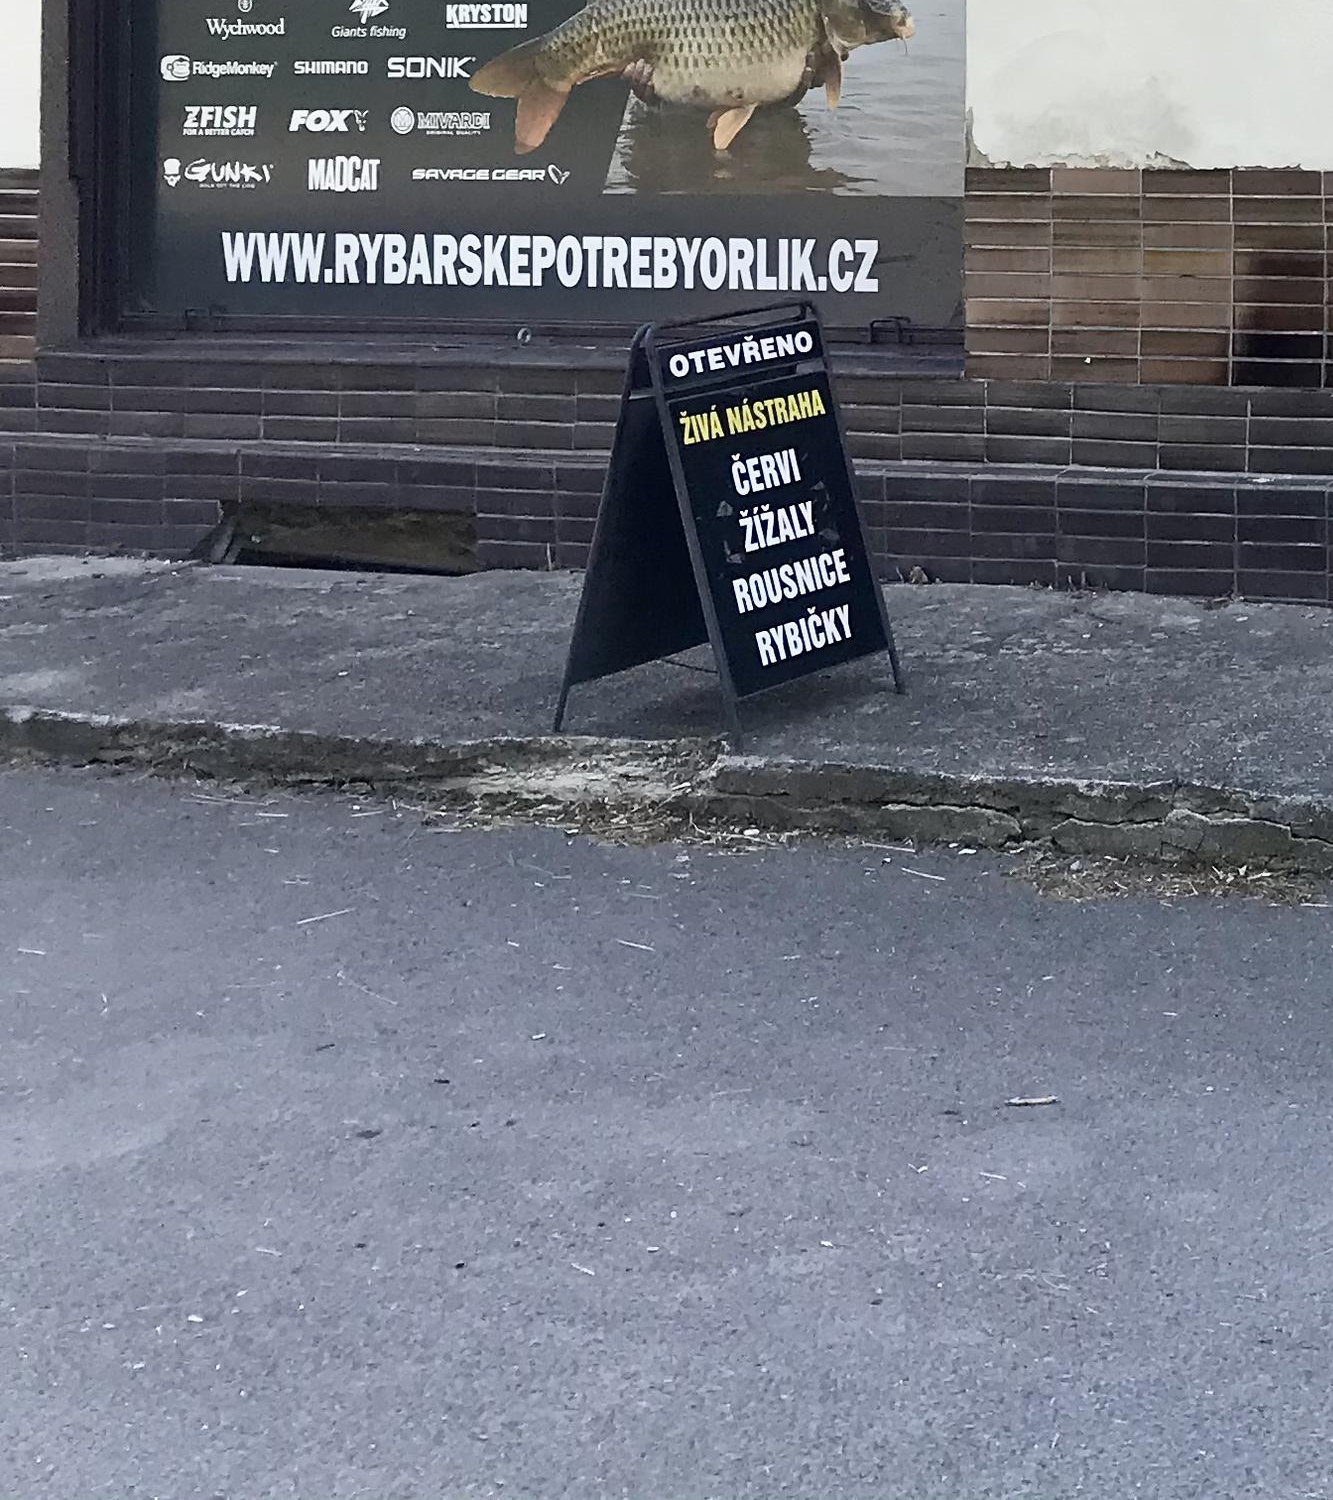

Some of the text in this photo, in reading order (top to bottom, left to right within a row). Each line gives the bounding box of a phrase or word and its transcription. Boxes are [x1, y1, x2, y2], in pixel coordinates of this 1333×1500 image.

[446, 3, 528, 28] KRYSTON
[206, 18, 285, 41] Wychwood
[331, 25, 406, 40] Giants fishing
[193, 59, 275, 78] RidgeMonkey
[387, 56, 472, 79] SONIK
[183, 105, 257, 128] ZFISH
[289, 109, 350, 132] FOX
[417, 111, 491, 130] MIVARDI
[184, 158, 271, 183] GUNKI
[308, 155, 380, 192] MADCAT
[411, 169, 546, 181] SAVAGE GEAR
[221, 231, 879, 293] WWW.RYBARSKEPOTREBYORLIK.CZ
[669, 330, 813, 378] OTEVŘENO
[679, 389, 826, 445] ŽIVÁ NÁSTRAHA
[731, 448, 801, 496] ČERVI
[739, 500, 816, 553] ŽÍŽALY
[732, 548, 851, 614] ROUSNICE
[755, 603, 852, 667] RYBIČKY
